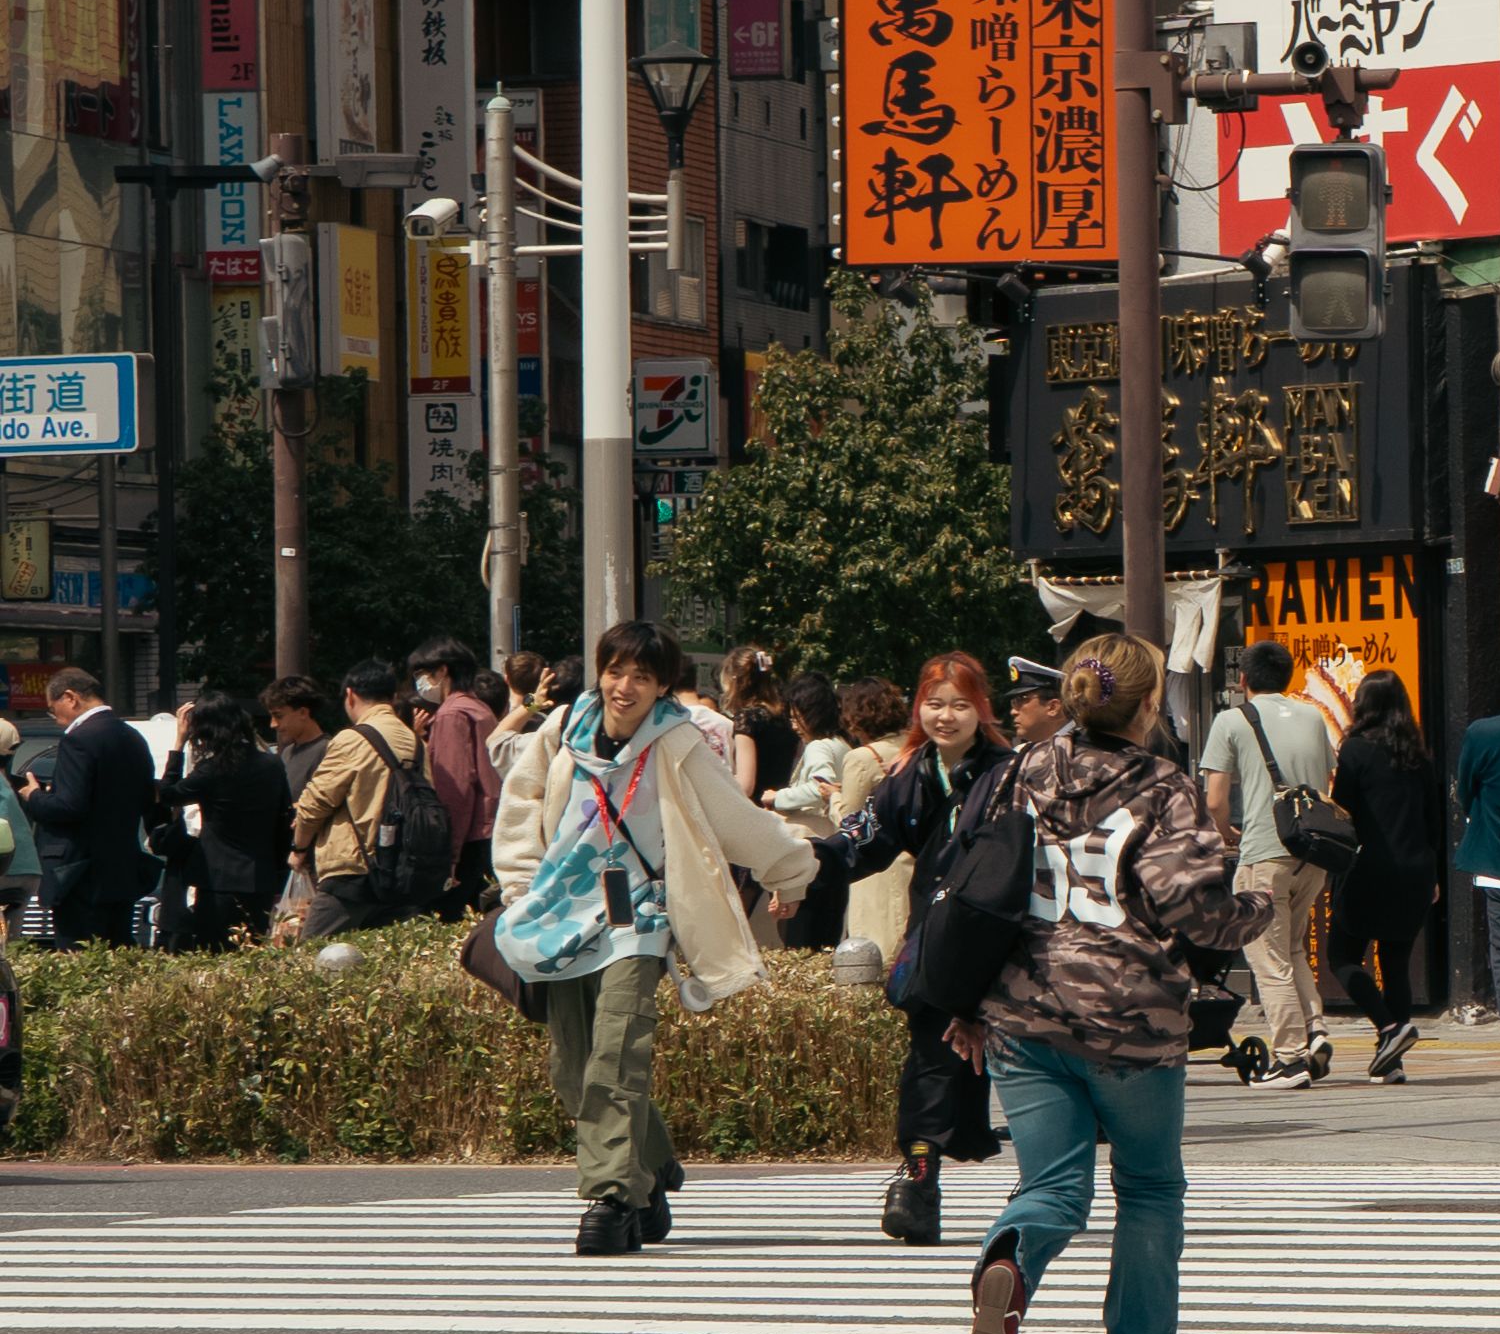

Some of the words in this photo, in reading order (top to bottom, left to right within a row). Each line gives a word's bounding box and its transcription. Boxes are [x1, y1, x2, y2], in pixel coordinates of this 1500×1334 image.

[751, 22, 778, 48] 6F
[231, 64, 255, 81] 2F
[218, 97, 246, 245] LAWSON
[209, 257, 258, 276] たばこ
[432, 380, 450, 391] 2F
[41, 418, 90, 439] Ave.
[1050, 376, 1284, 534] 萬軒
[684, 472, 703, 492] 酒
[1243, 555, 1421, 627] RAMEN
[1293, 632, 1398, 669] 味噌らーめん
